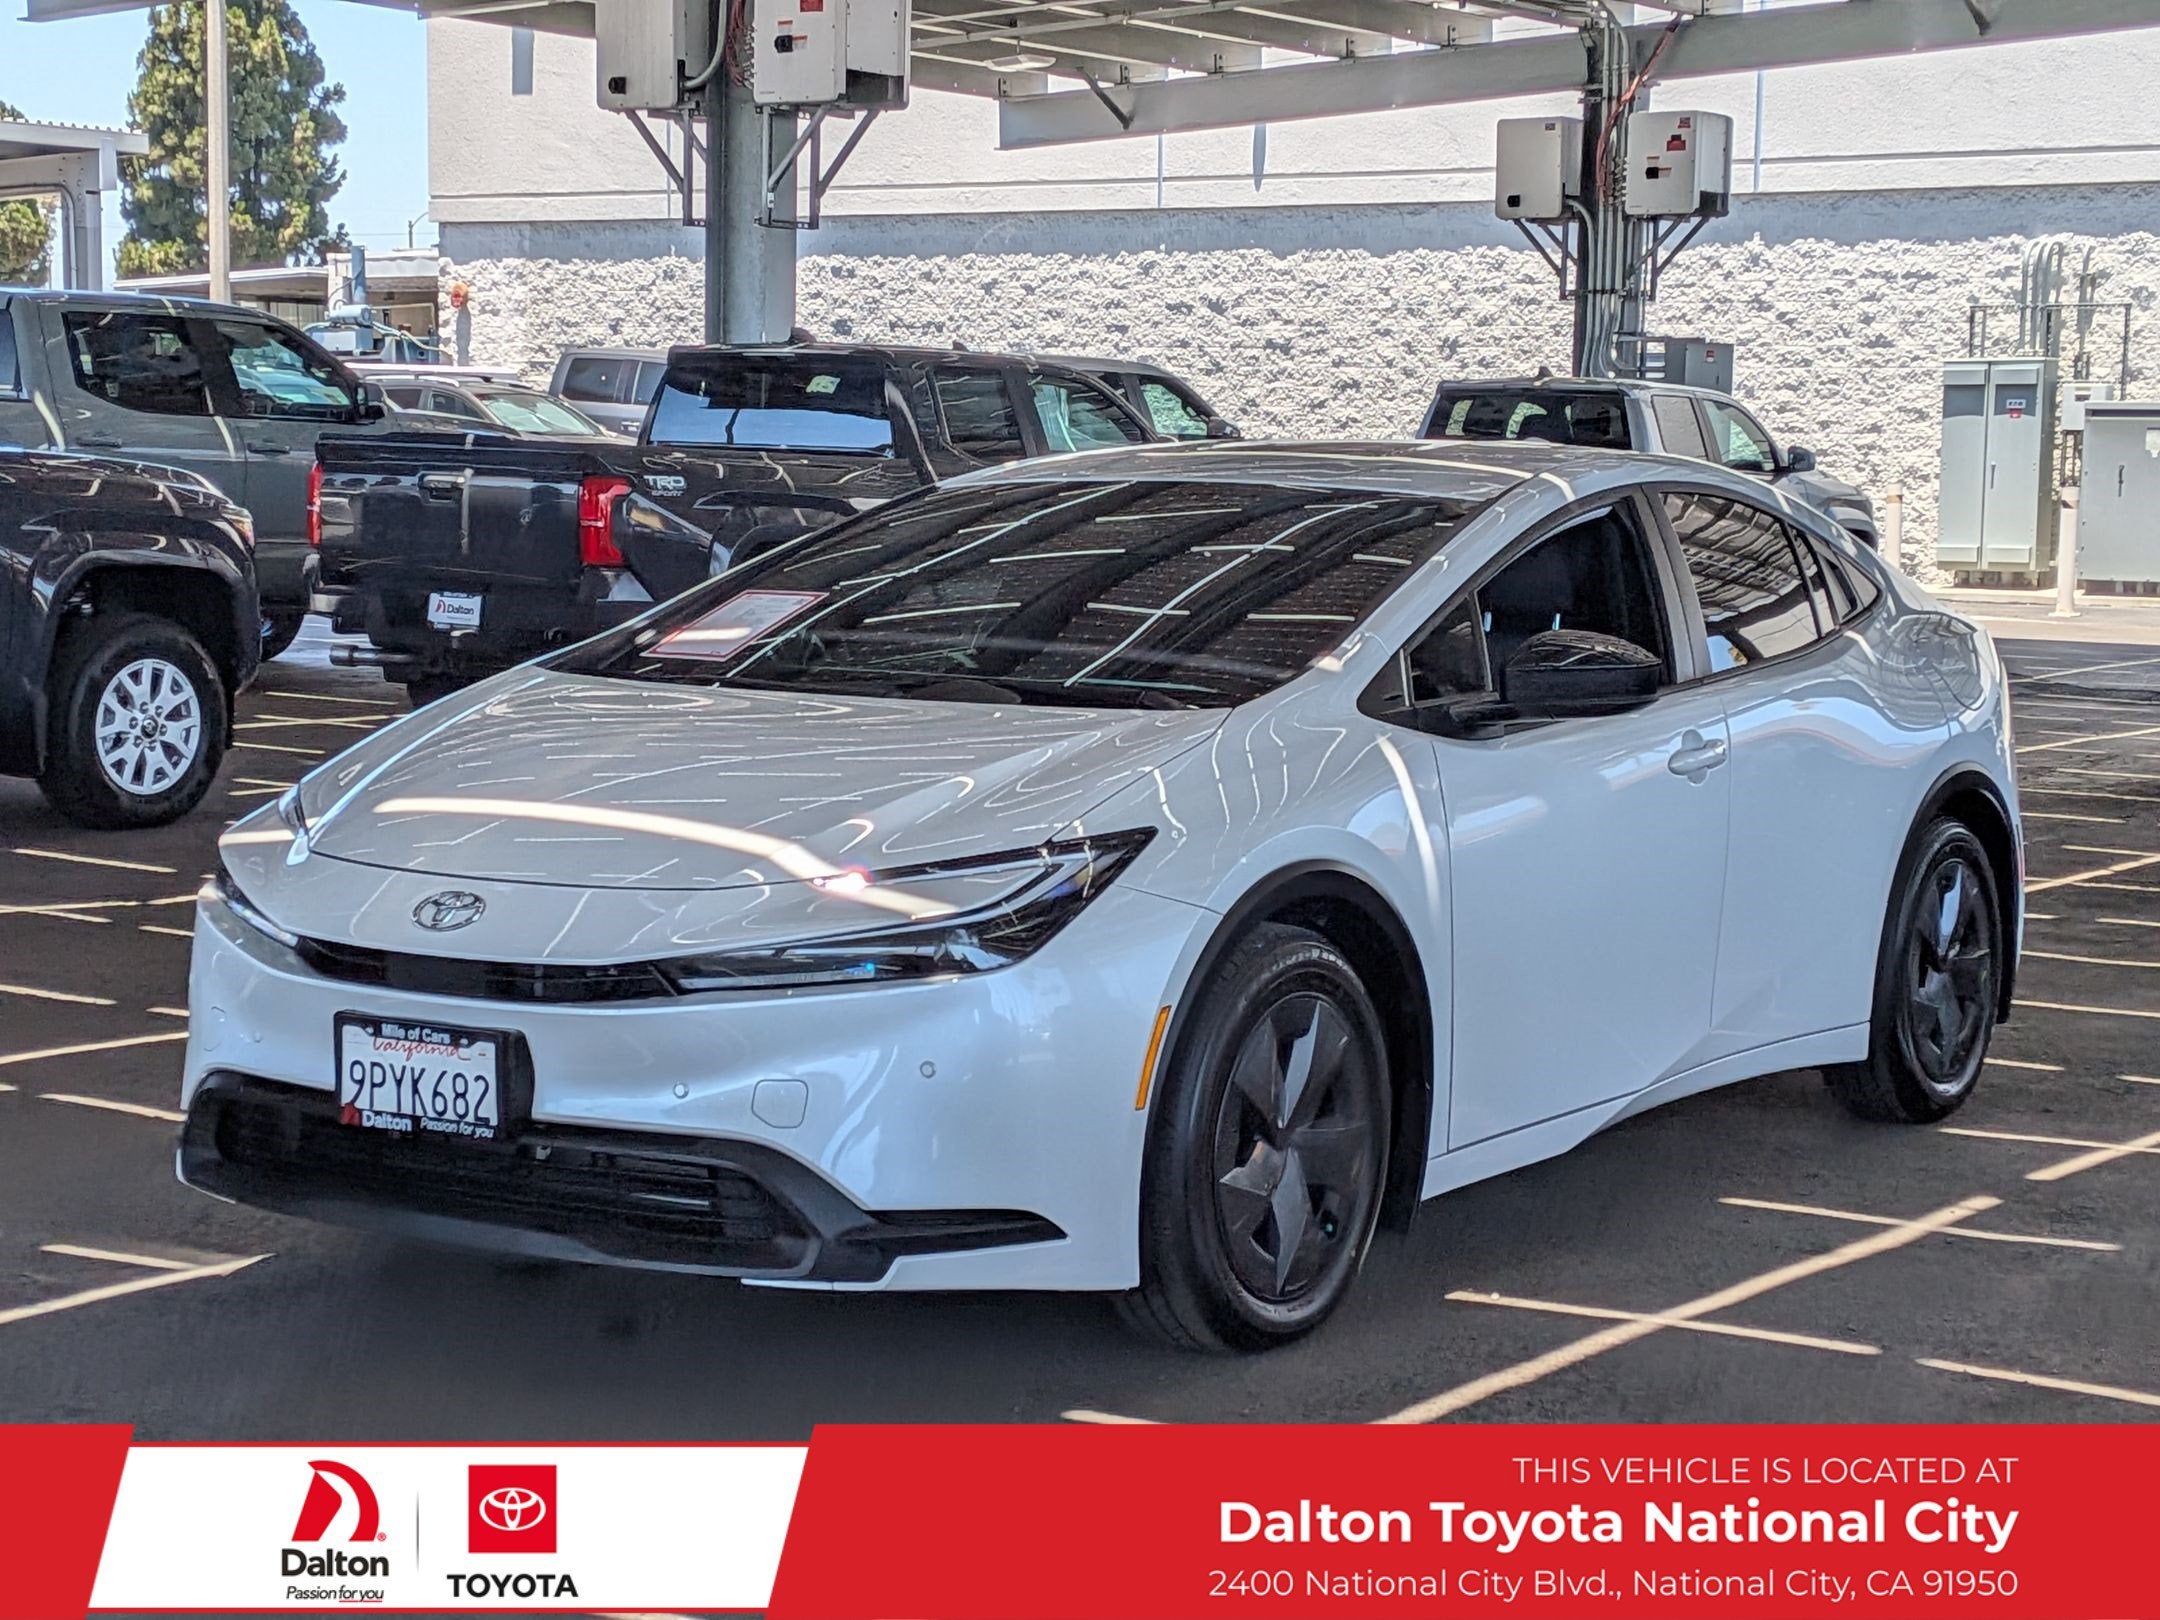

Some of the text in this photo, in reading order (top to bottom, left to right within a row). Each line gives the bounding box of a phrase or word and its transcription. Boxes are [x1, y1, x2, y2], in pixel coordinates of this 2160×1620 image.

[643, 475, 686, 489] TRD
[447, 604, 475, 615] Dalton
[382, 1024, 450, 1044] Mile of Cars
[350, 1060, 490, 1124] 9PYK682
[362, 1111, 494, 1139] Dalton Passion for you
